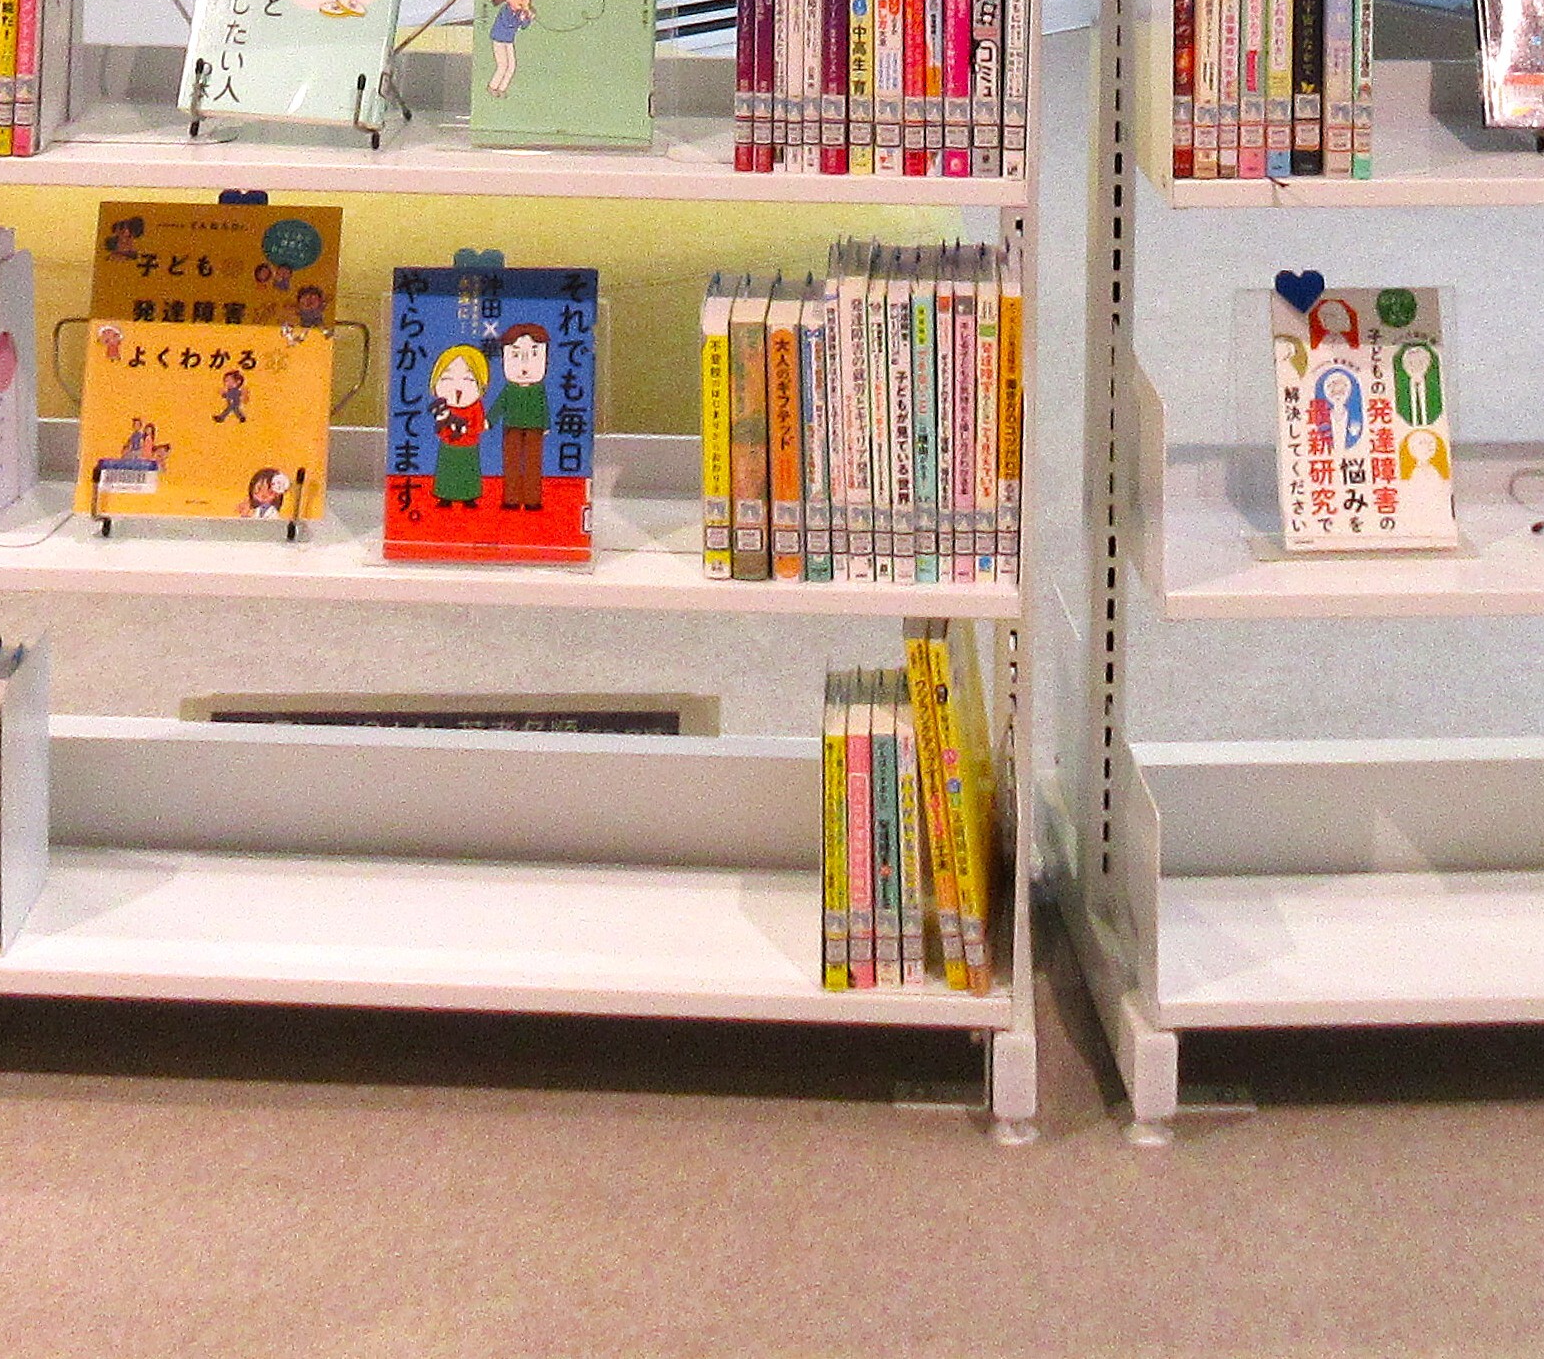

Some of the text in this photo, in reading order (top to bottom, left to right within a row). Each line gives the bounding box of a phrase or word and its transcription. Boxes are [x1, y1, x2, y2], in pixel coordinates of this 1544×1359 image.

[391, 271, 430, 522] やらかしてます。
[556, 272, 590, 473] それでも毎日
[1284, 386, 1306, 533] 解決してください
[1367, 329, 1399, 531] 子どもの発達障害の
[1307, 398, 1339, 533] 最新研究で
[1340, 458, 1369, 533] 悩みを
